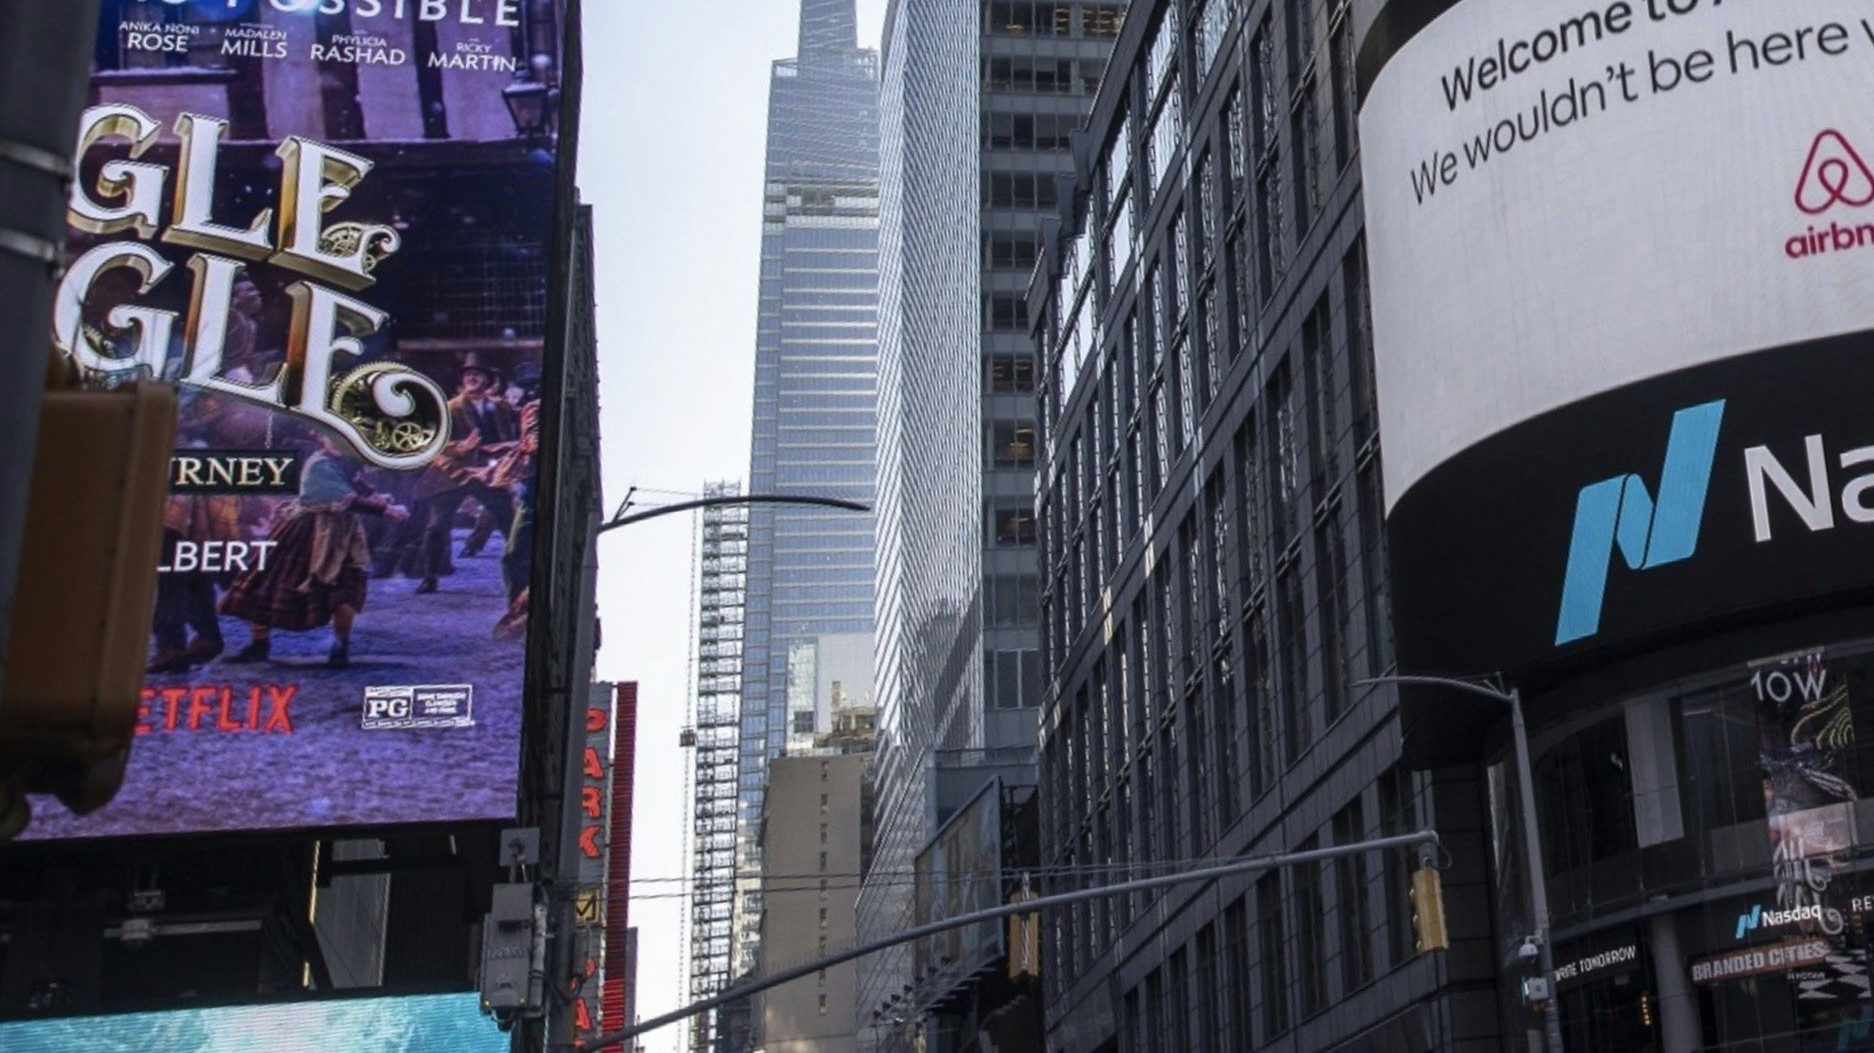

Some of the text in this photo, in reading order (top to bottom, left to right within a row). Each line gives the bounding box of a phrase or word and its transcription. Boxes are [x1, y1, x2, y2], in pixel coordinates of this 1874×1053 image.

[128, 32, 189, 53] ROSE
[225, 27, 287, 41] MADALEN
[221, 39, 288, 58] MILLS
[310, 44, 406, 66] RASHAD
[456, 41, 492, 55] RICKY
[1442, 1, 1633, 112] Welcome
[427, 51, 517, 73] MARTIN
[1410, 151, 1458, 205] We
[1464, 61, 1639, 170] wouldn’t
[1648, 49, 1715, 94] be
[1726, 20, 1849, 74] here
[169, 456, 295, 486] RNEY
[157, 540, 280, 573] BERT
[368, 698, 409, 718] PG
[1762, 904, 1821, 928] Nasdaq
[1692, 940, 1826, 982] BRANDED CITIES
